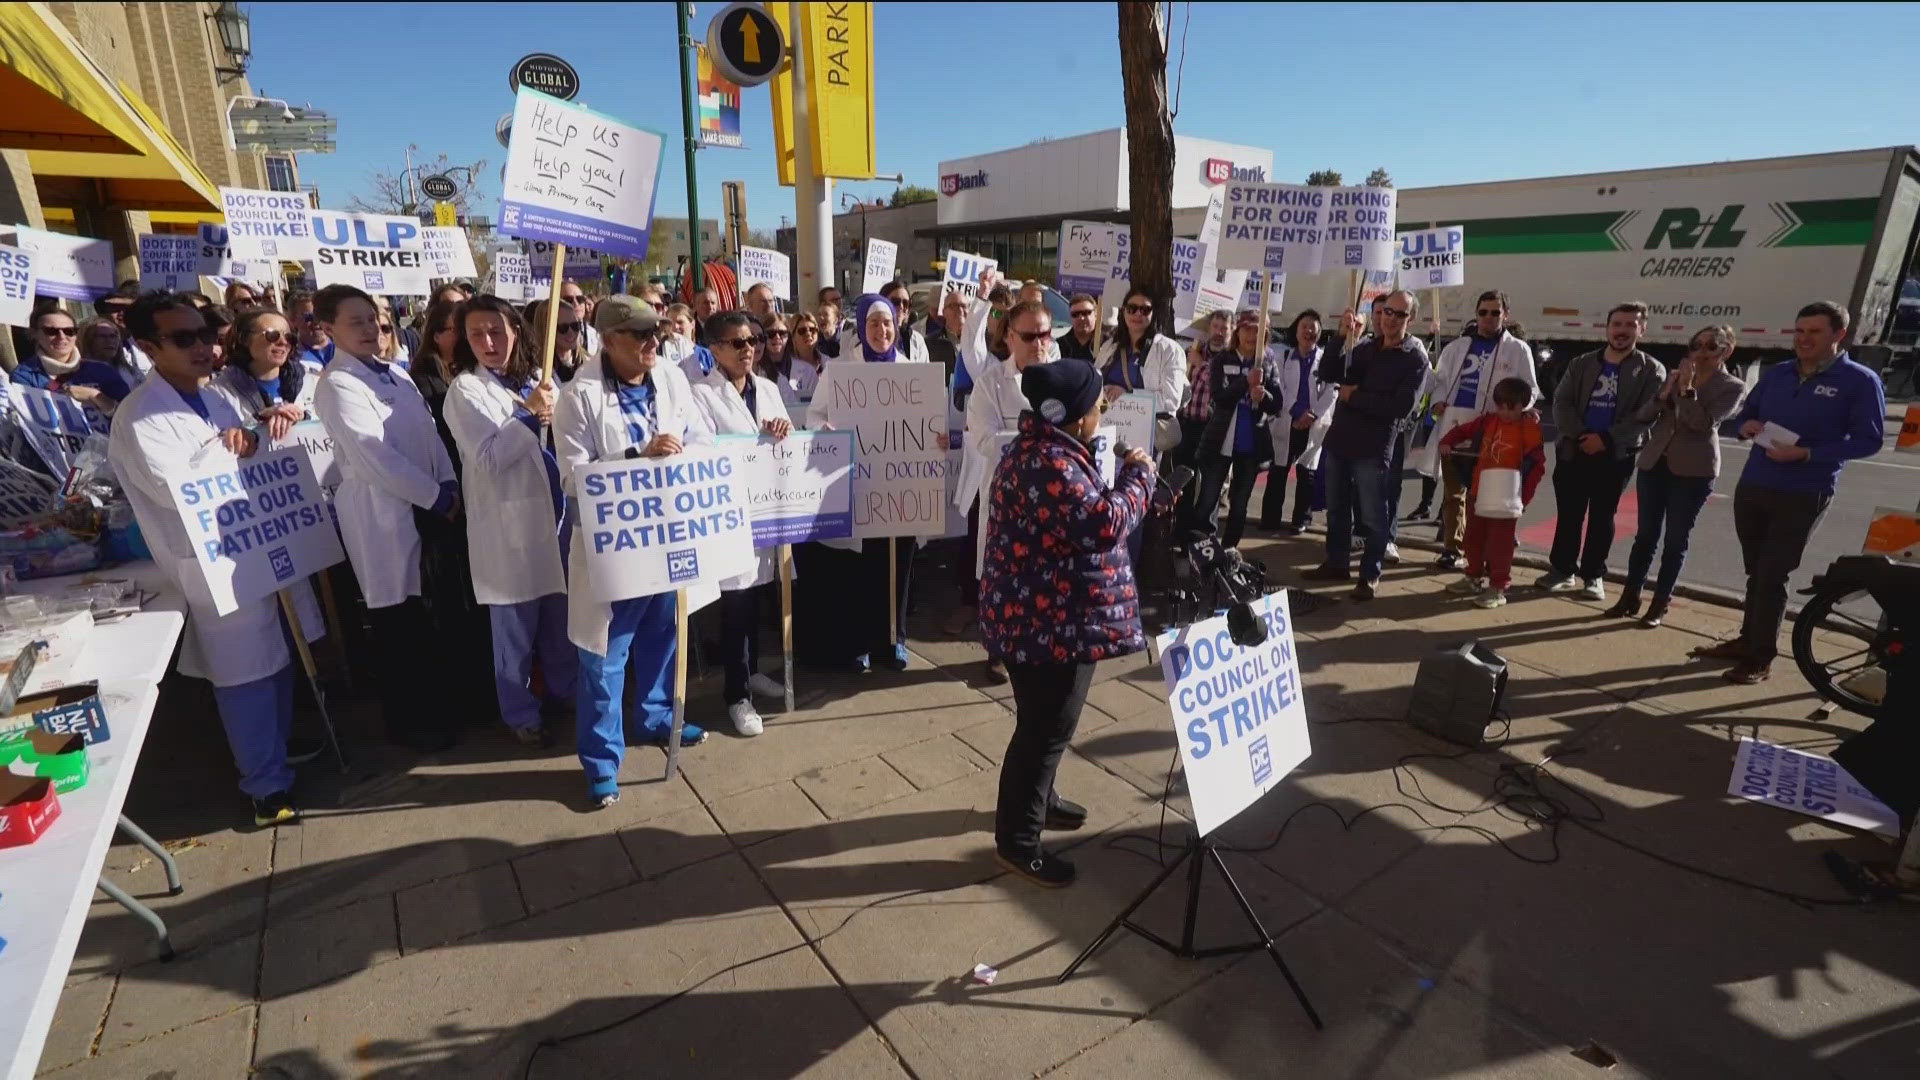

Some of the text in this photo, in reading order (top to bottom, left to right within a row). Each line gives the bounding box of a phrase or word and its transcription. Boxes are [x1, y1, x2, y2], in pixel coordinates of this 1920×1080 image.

[826, 2, 849, 86] PARK
[525, 71, 569, 88] GLOBAL
[529, 64, 564, 73] MIDTOWN
[531, 101, 577, 146] Help
[534, 147, 625, 192] Help you!
[226, 195, 305, 209] DOCTORS
[1229, 187, 1323, 207] STRIKING
[228, 209, 306, 221] COUNCIL ON
[1231, 206, 1272, 222] FOR
[1279, 209, 1318, 225] OUR
[1354, 209, 1387, 224] OUR
[231, 221, 309, 237] STRIKE!
[312, 216, 417, 248] ULP
[1226, 225, 1322, 245] PATIENTS!
[1643, 205, 1747, 249] R+L
[142, 239, 197, 249] DOCTORS
[142, 250, 184, 259] COUNCIL
[1401, 231, 1462, 256] ULP
[142, 261, 197, 274] STRIKE!
[318, 248, 421, 268] STRIKE!
[1402, 253, 1461, 270] STRIKE!
[1640, 256, 1735, 278] CARRIERS
[833, 377, 922, 409] NO ONE
[180, 456, 299, 505] STRIKING
[585, 456, 732, 496] STRIKING
[885, 459, 944, 481] DOCTORS
[197, 499, 255, 533] FOR
[258, 483, 304, 514] OUR
[596, 484, 732, 525] FOR OUR
[854, 488, 944, 526] URNOUT
[204, 504, 324, 562] PATIENTS!
[593, 508, 745, 554] PATIENTS!
[1179, 639, 1292, 714] COUNCIL ON
[1187, 668, 1297, 760] STRIKE!
